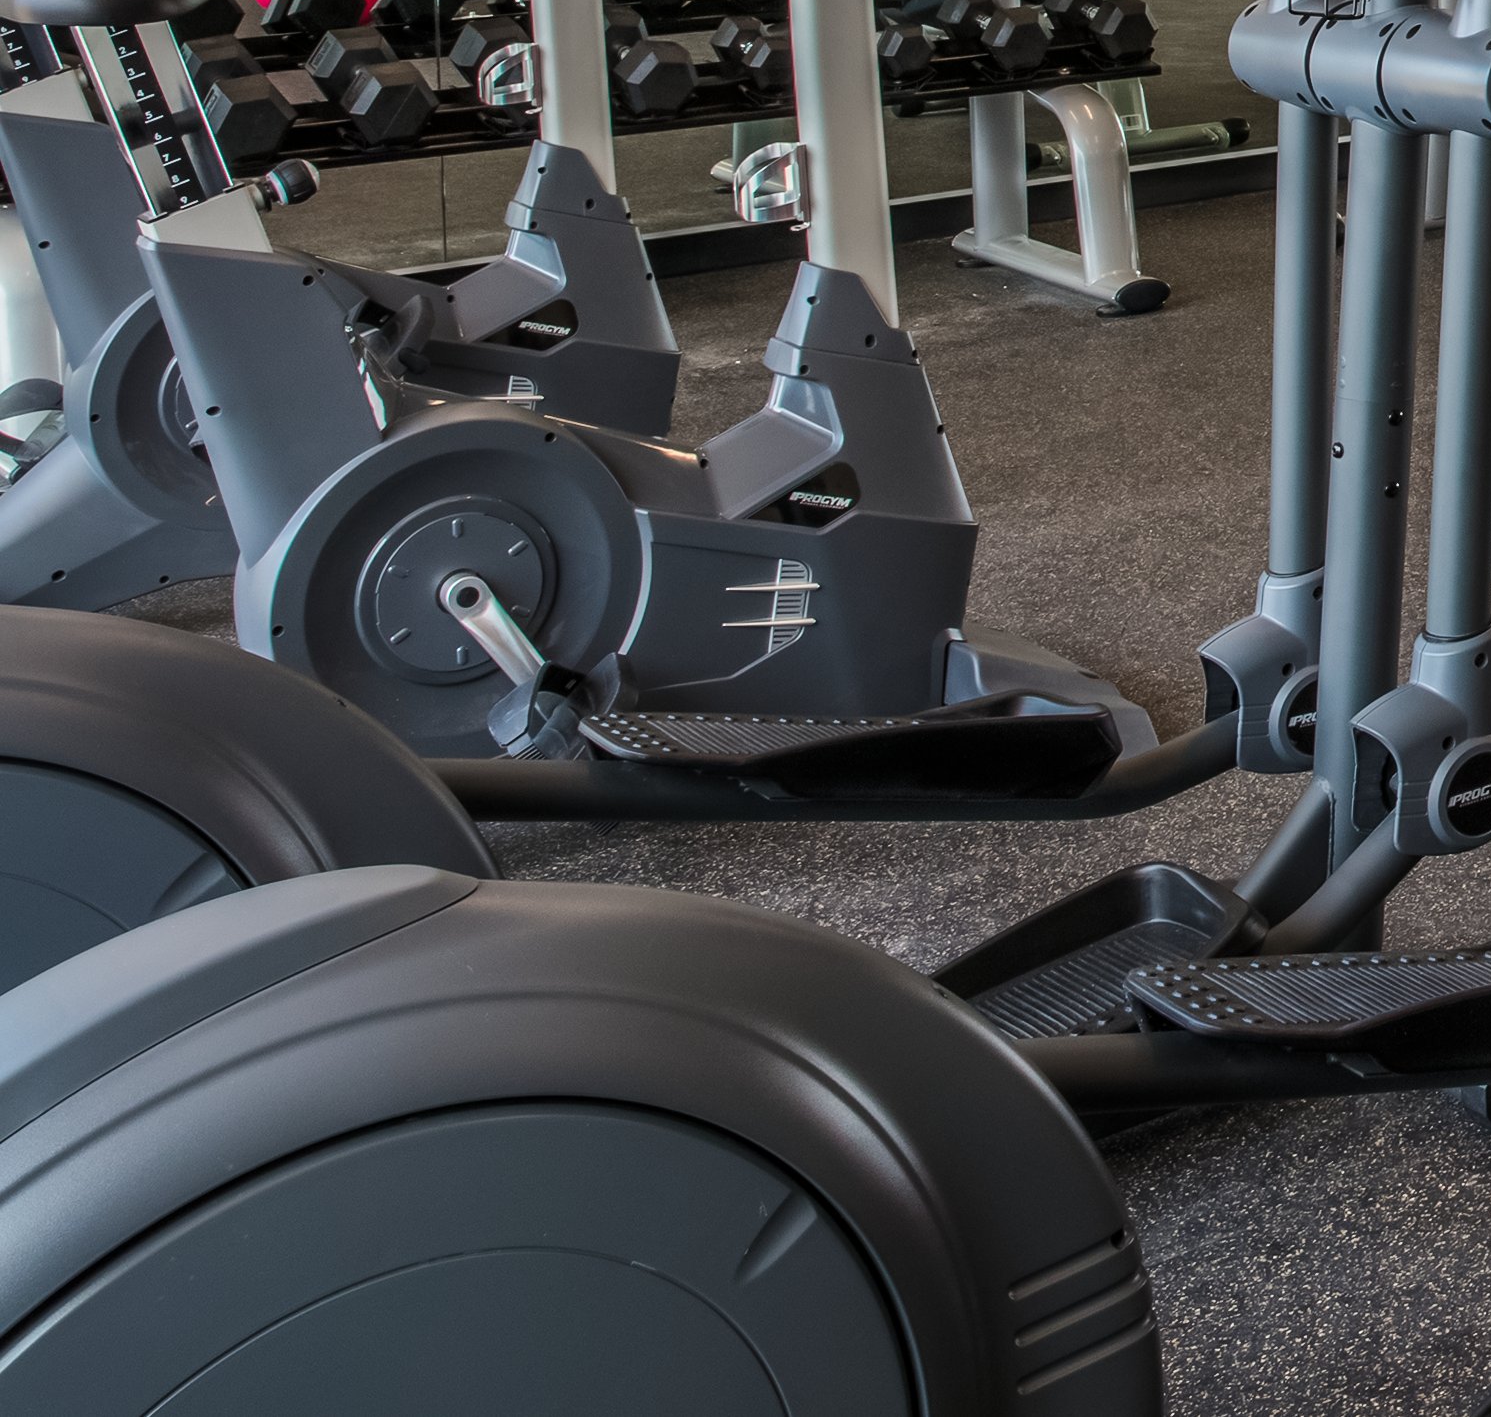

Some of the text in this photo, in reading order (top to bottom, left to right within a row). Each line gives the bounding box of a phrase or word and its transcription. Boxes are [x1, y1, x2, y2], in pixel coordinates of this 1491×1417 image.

[109, 25, 116, 33] 1
[118, 46, 126, 55] 2
[127, 67, 136, 76] 3
[136, 89, 144, 97] 4
[145, 110, 153, 119] 5
[154, 132, 162, 141] 6
[162, 153, 170, 162] 7
[171, 174, 179, 183] 8
[180, 195, 188, 204] 9
[518, 320, 571, 336] PROGYM
[789, 491, 853, 508] PROGYM
